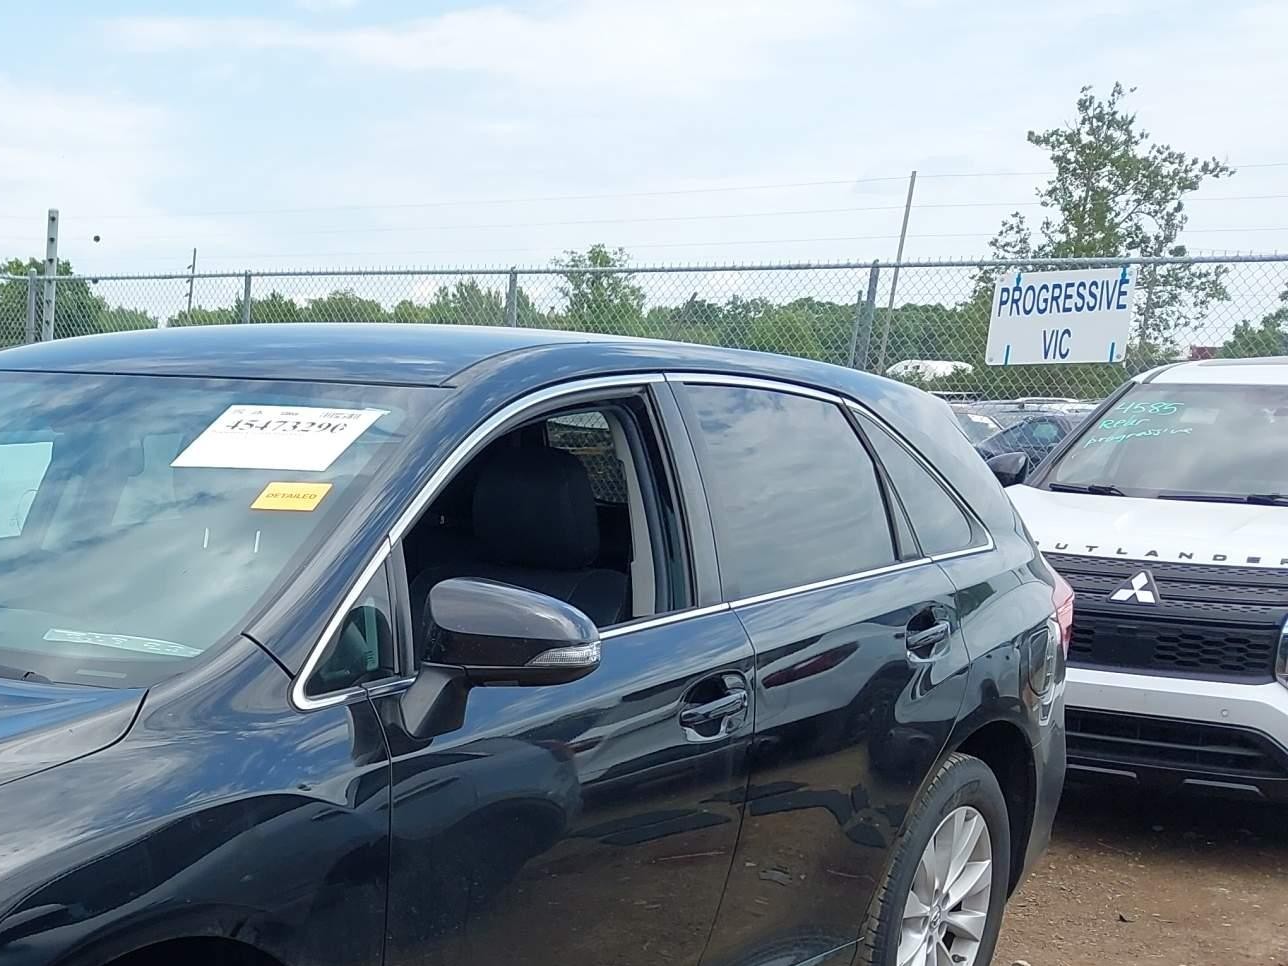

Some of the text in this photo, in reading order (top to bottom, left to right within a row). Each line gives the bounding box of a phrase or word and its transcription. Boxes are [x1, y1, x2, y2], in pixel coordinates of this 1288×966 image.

[998, 279, 1130, 317] PROGRESSIVE
[1043, 328, 1072, 359] VIC
[265, 492, 318, 500] DETAILED
[1034, 540, 1288, 566] UTLANDER
